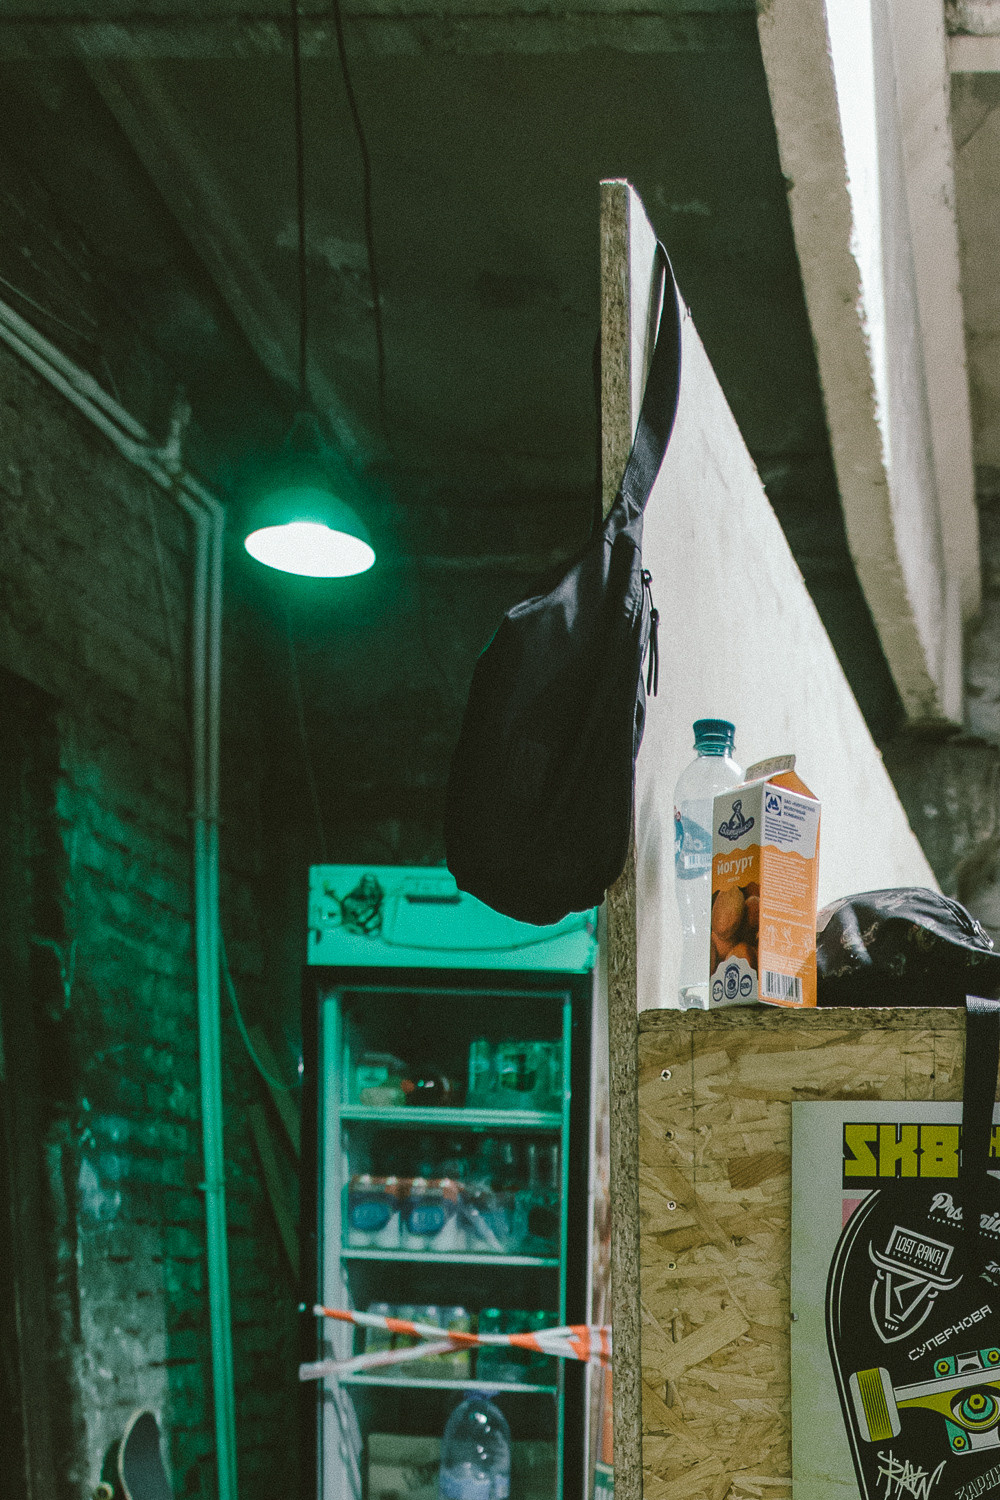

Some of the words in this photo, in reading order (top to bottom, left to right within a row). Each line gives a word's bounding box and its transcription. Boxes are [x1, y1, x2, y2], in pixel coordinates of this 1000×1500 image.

[717, 855, 754, 875] йогурт
[894, 1235, 918, 1256] LOST
[916, 1241, 945, 1266] RANCH
[908, 1304, 993, 1361] СУПЕРНОВА
